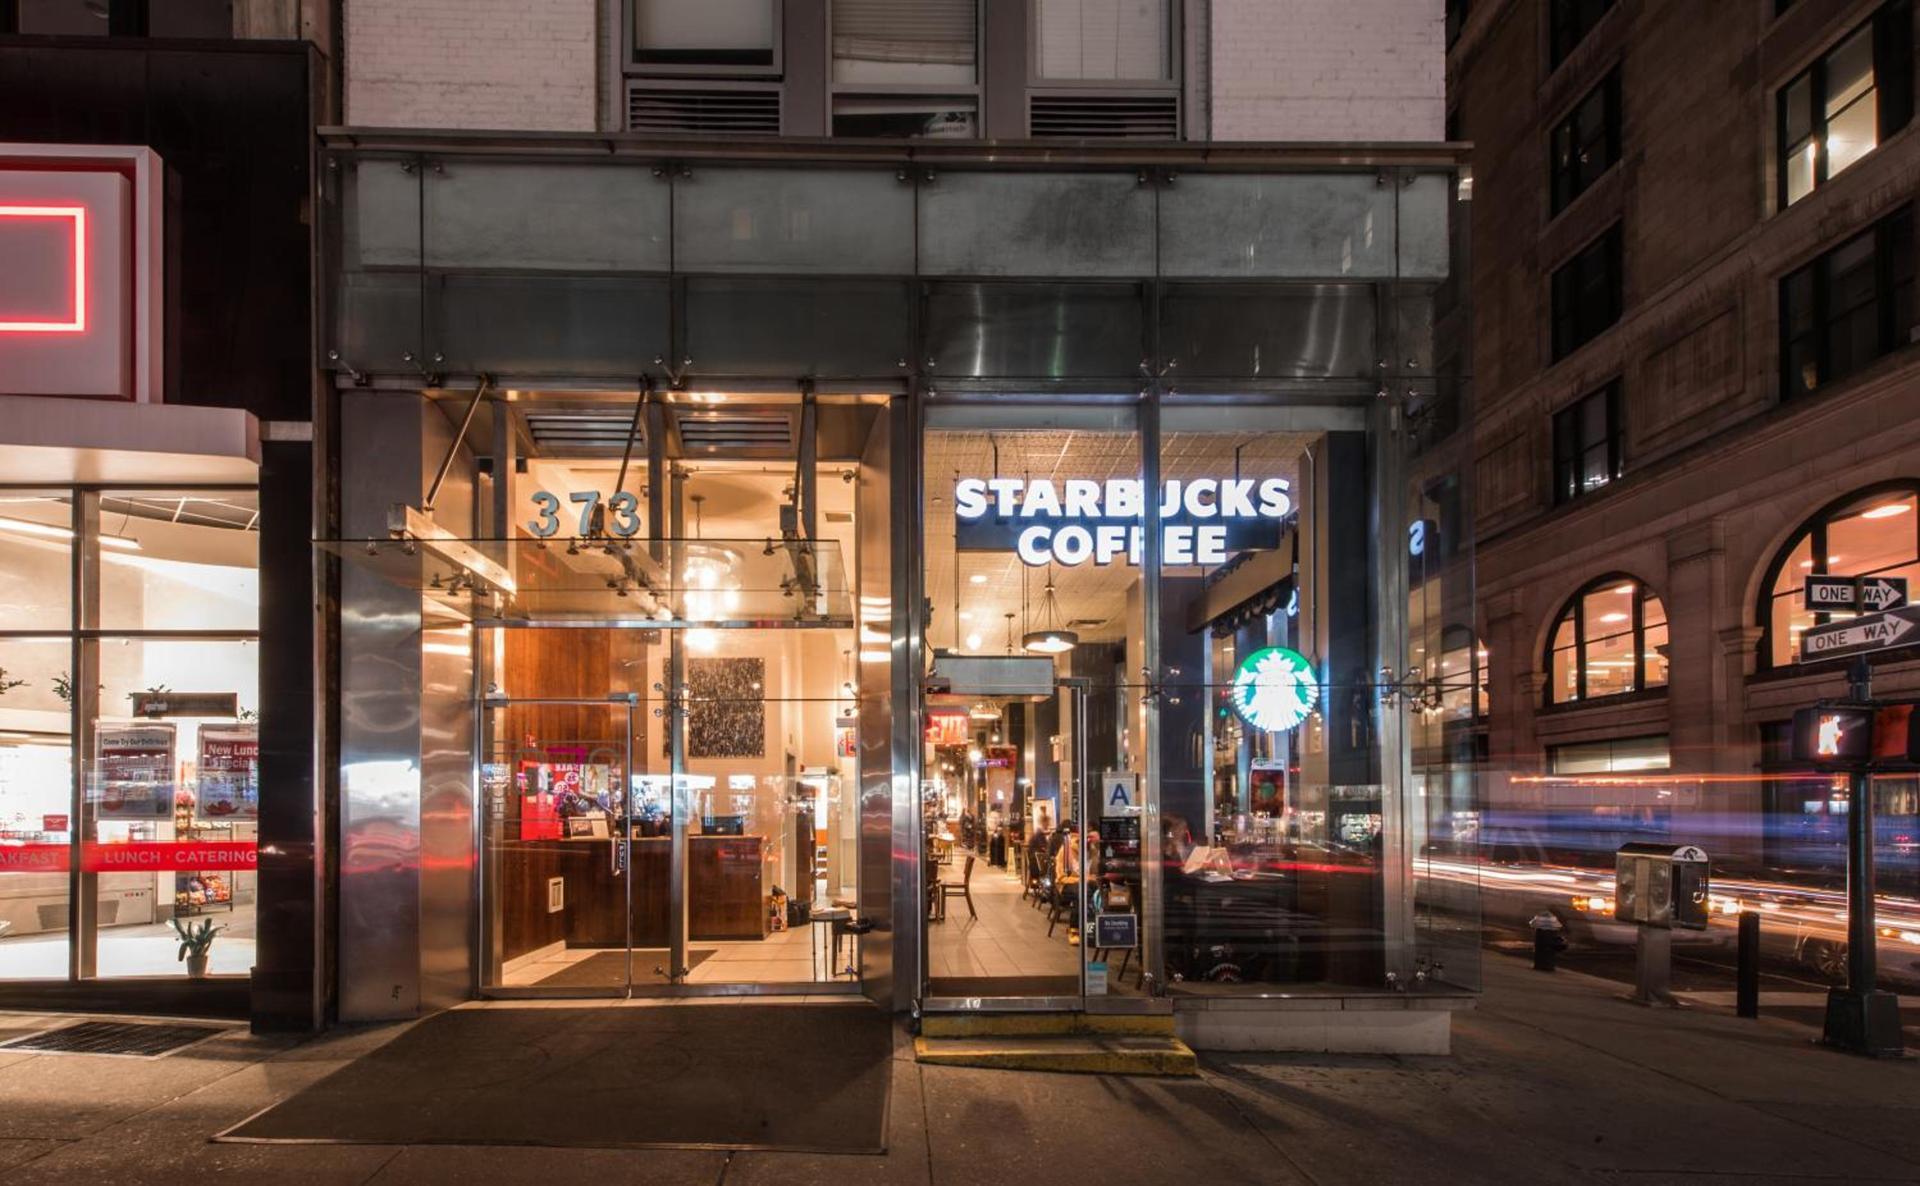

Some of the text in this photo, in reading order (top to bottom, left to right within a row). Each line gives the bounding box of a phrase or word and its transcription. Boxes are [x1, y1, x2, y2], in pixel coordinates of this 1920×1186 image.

[955, 478, 1291, 519] STARBUCKS
[528, 490, 641, 537] 373
[1819, 586, 1892, 602] ONE WAY
[1815, 620, 1900, 650] ONE WAY
[208, 743, 232, 755] New
[1110, 783, 1130, 806] A
[104, 850, 257, 864] LUNCH CATERING
